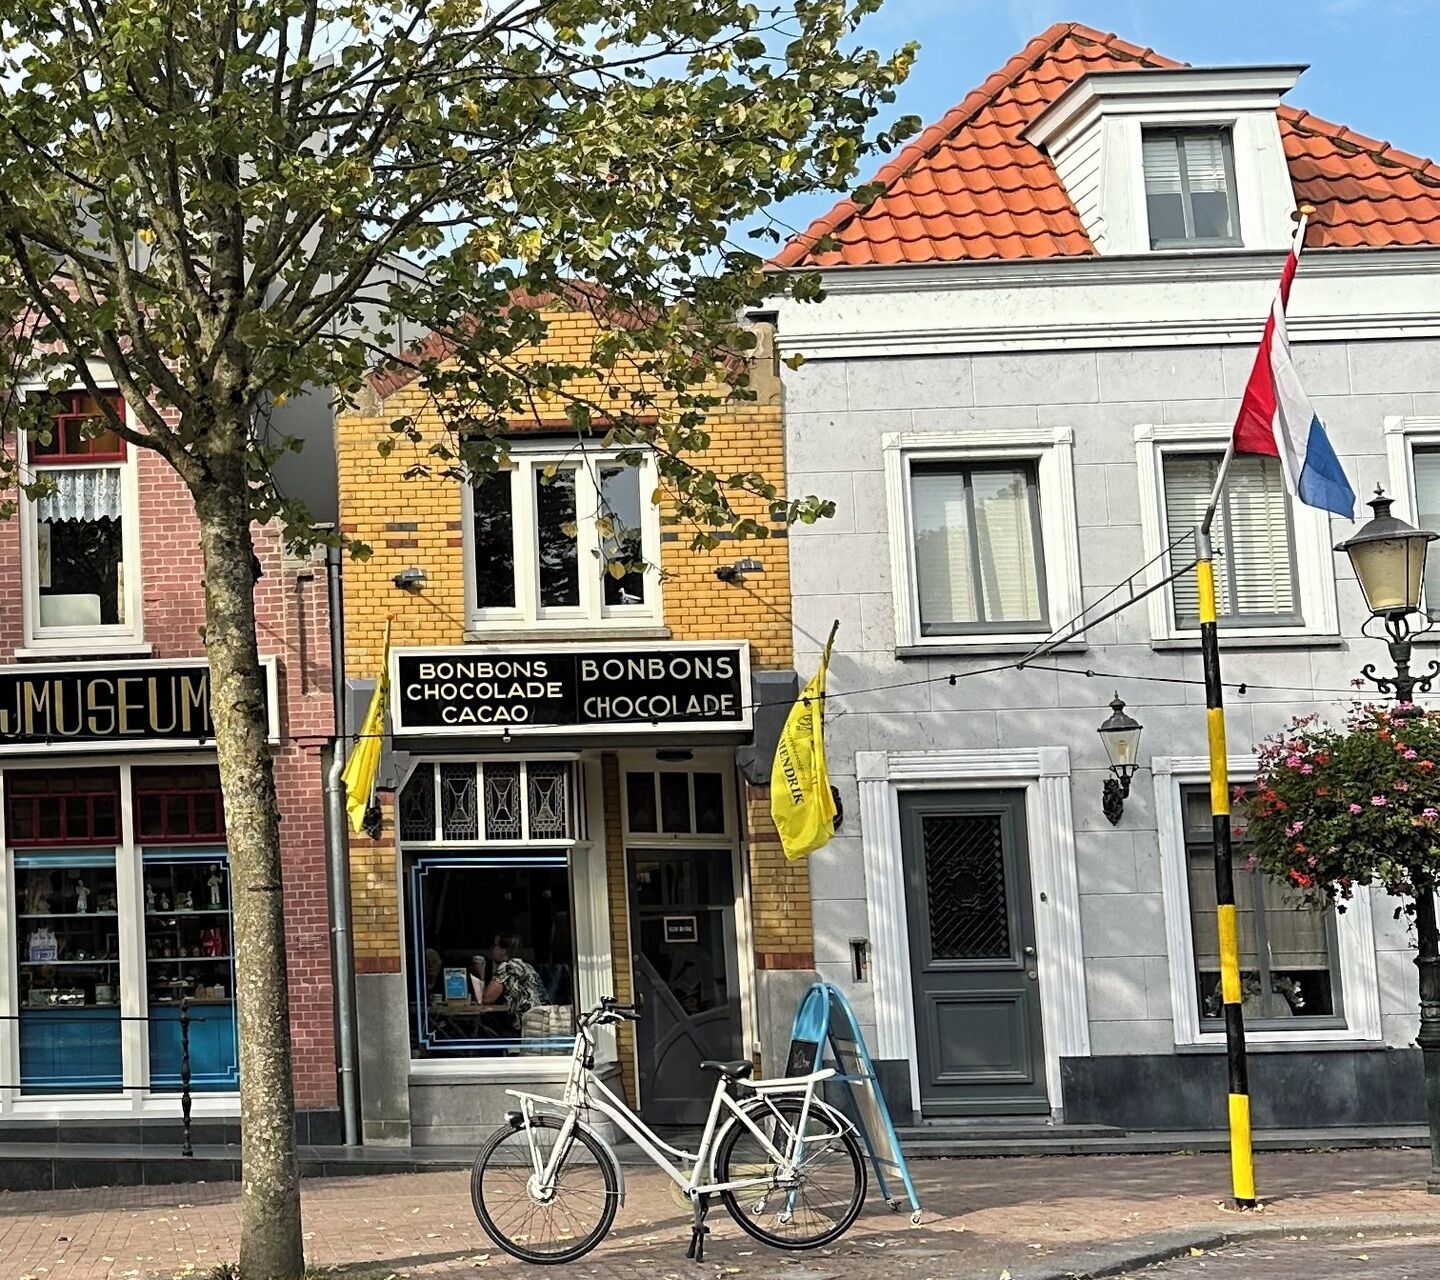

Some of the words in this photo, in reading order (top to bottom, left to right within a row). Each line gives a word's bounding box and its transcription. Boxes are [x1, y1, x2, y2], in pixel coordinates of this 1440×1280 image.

[419, 660, 548, 680] BONBONS
[581, 657, 734, 681] BONBONS
[407, 681, 563, 701] CHOCOLADE
[441, 704, 529, 724] CACAO
[583, 694, 735, 719] CHOCOLADE
